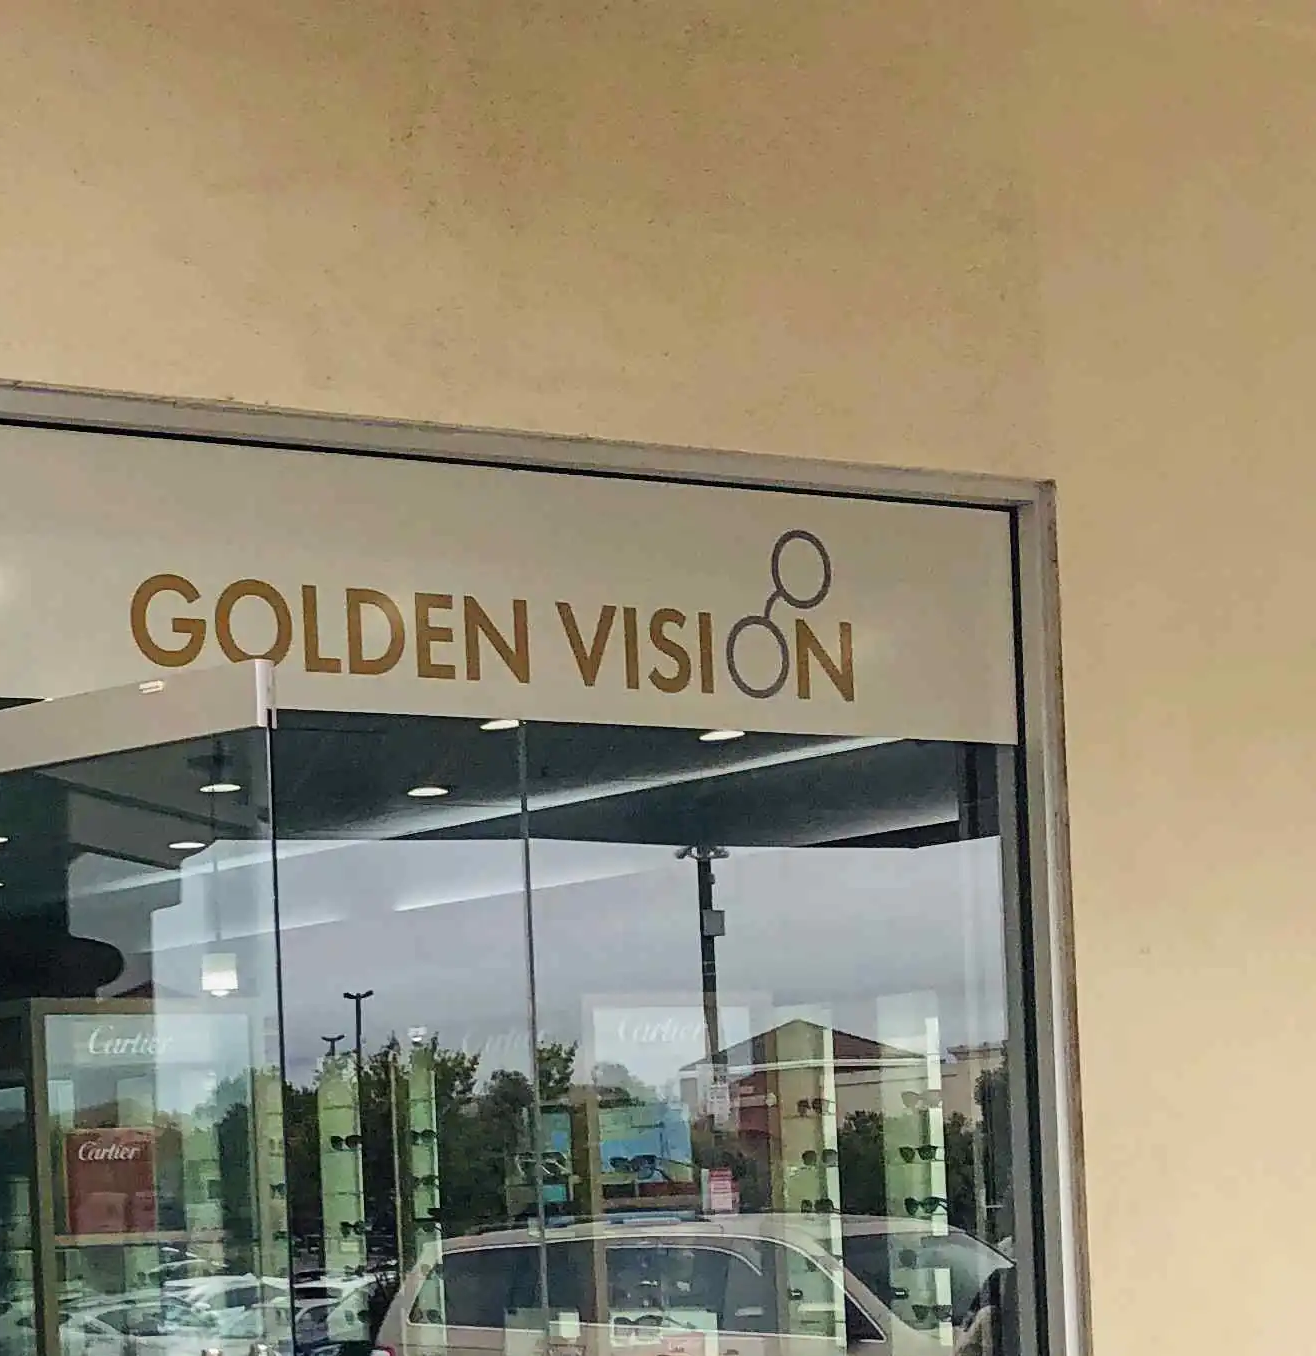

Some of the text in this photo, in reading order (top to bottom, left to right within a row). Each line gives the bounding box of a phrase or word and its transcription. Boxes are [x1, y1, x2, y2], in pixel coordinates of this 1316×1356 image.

[130, 573, 855, 703] GOLDEN VISION
[88, 1025, 173, 1056] Cartier
[78, 1140, 140, 1162] Cartier
